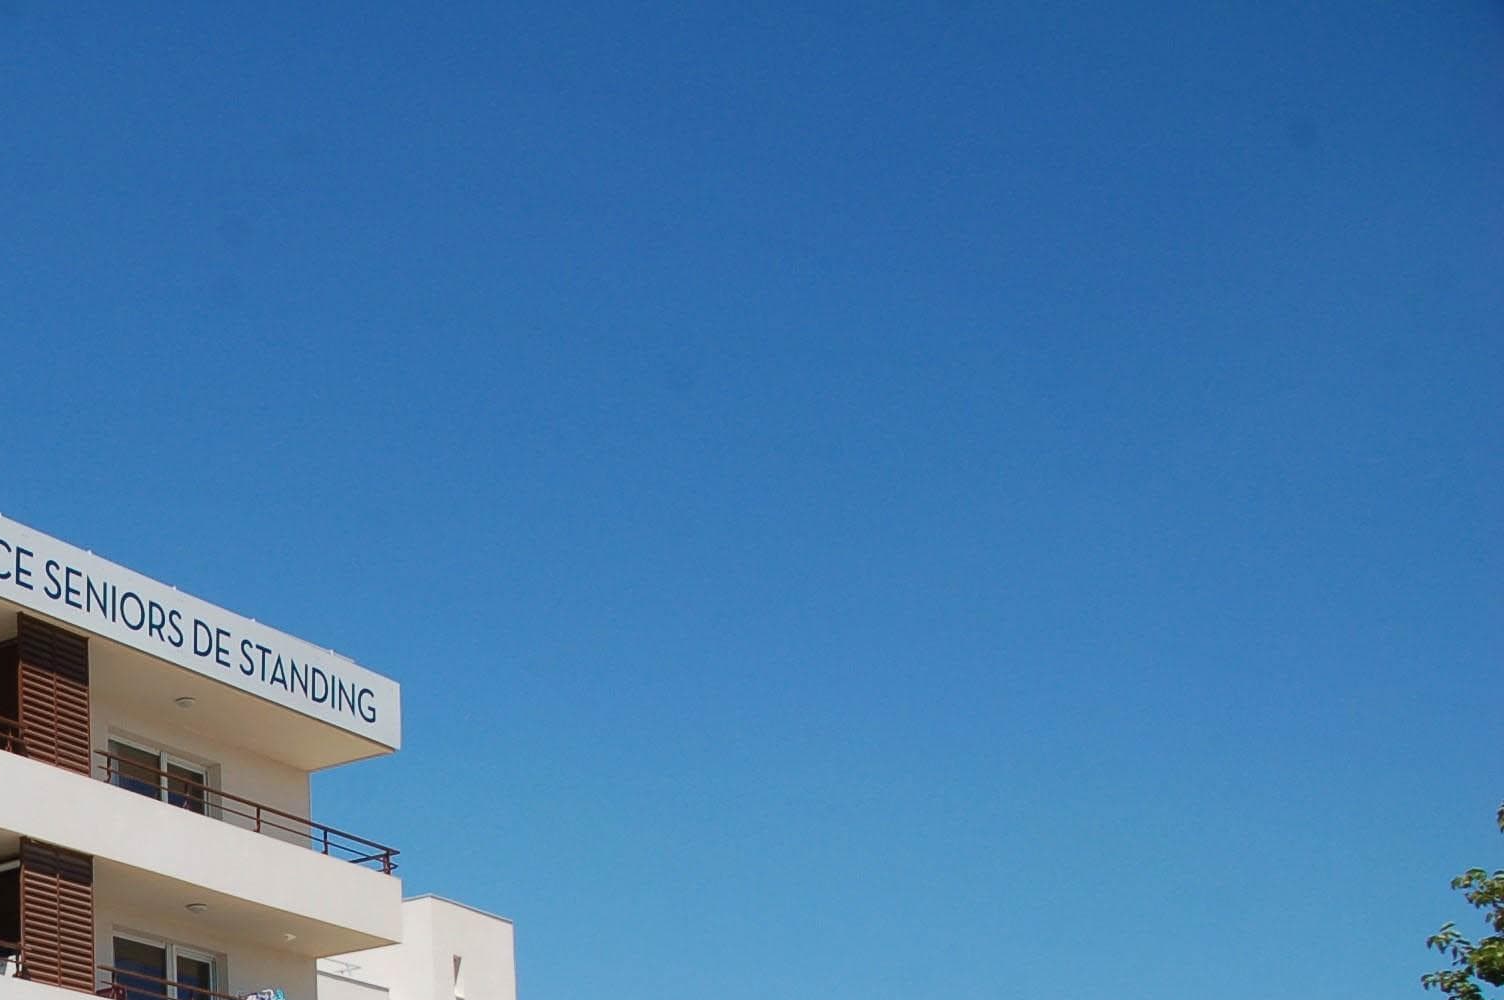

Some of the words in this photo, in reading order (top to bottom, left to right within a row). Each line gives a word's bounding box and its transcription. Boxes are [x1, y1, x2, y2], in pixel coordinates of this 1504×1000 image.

[44, 559, 185, 649] SENIORS
[193, 619, 231, 667] DE
[239, 638, 378, 725] STANDING
